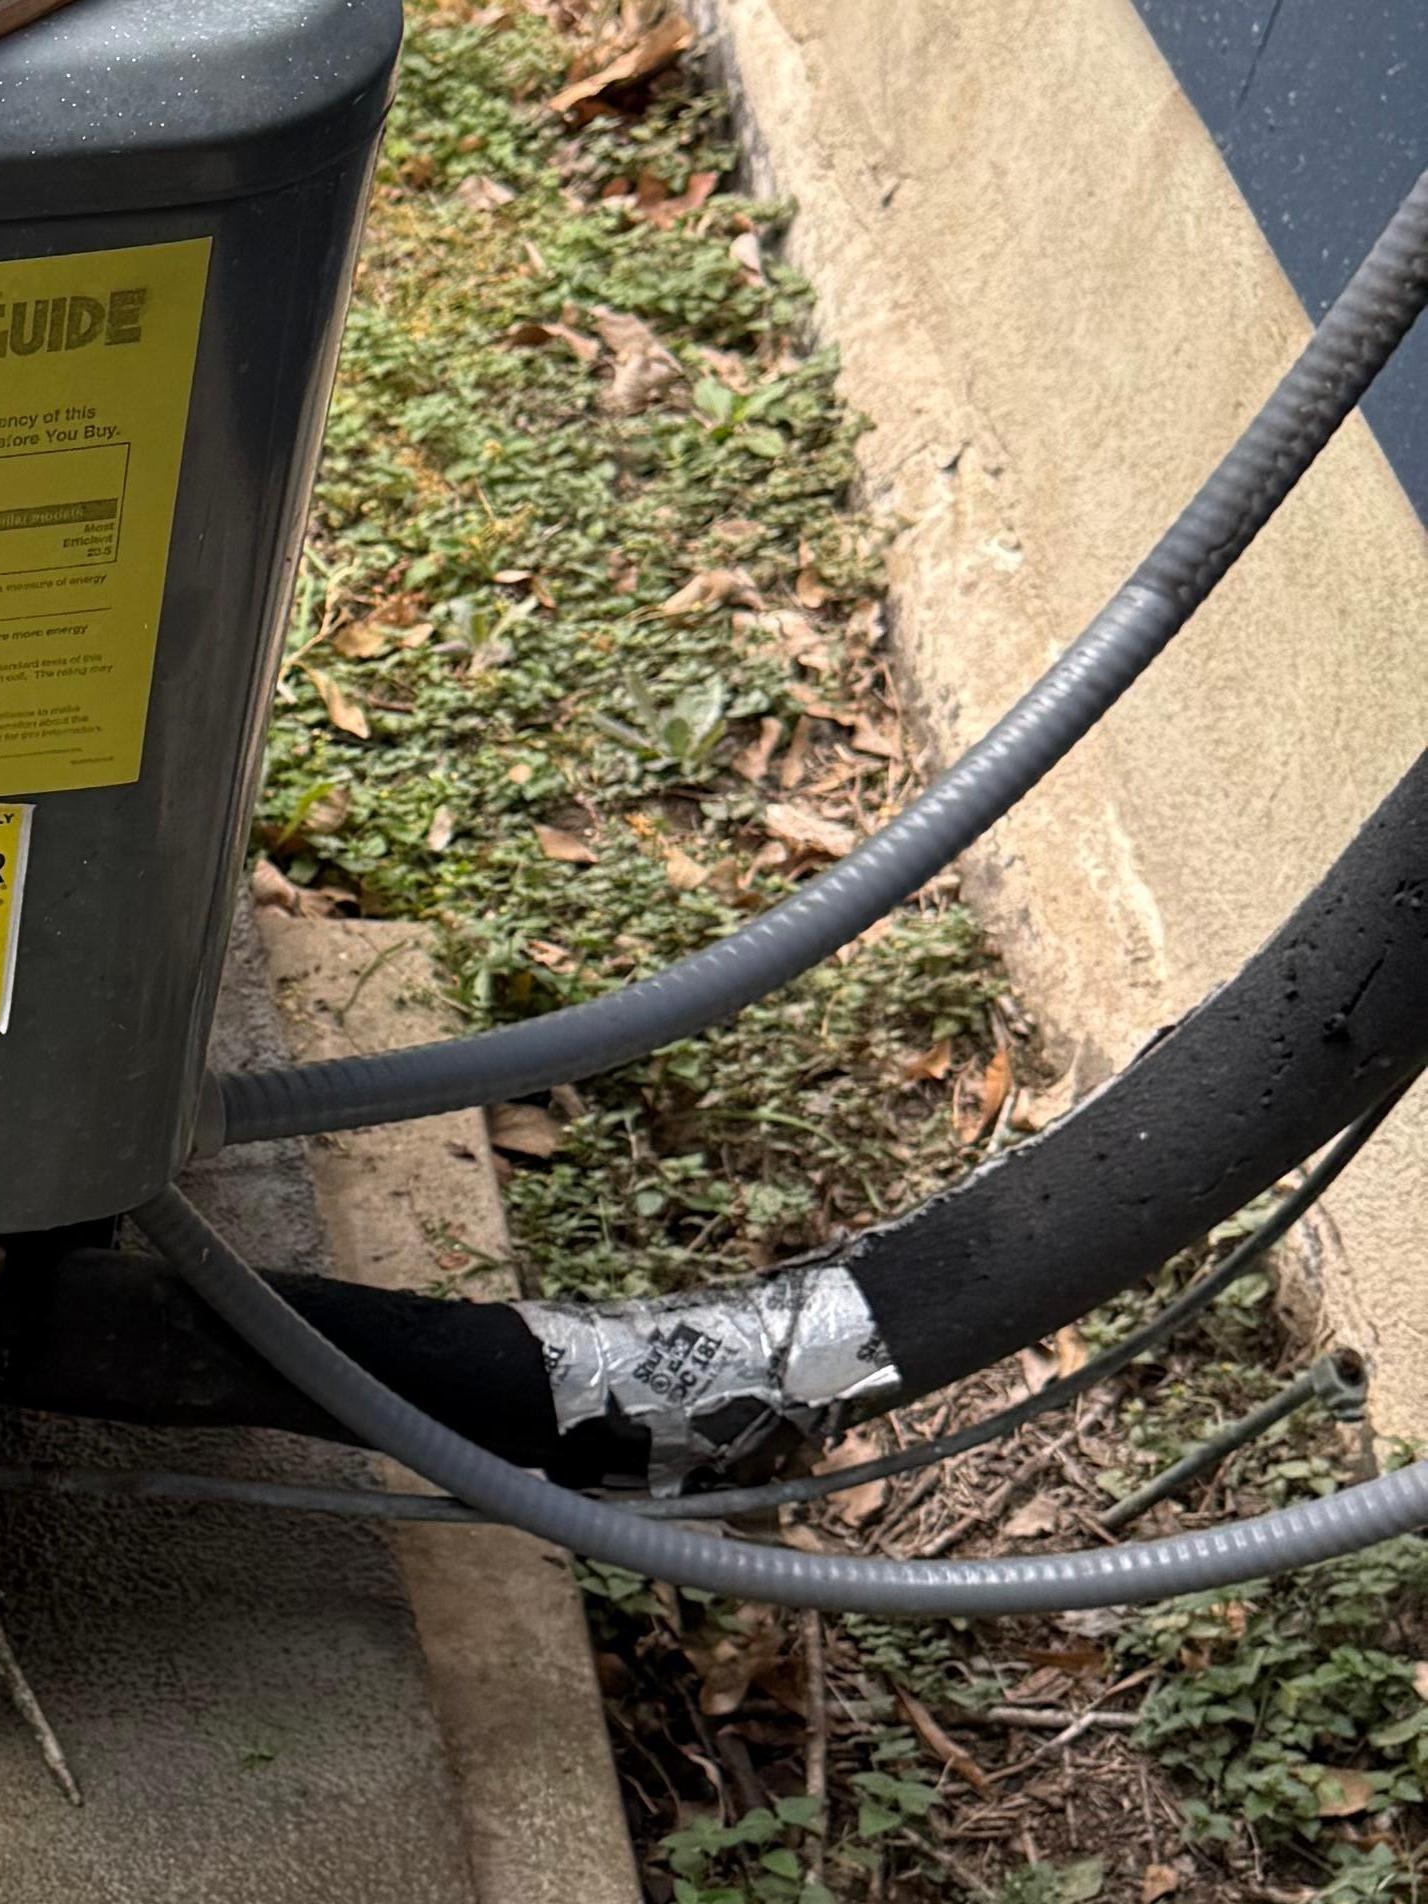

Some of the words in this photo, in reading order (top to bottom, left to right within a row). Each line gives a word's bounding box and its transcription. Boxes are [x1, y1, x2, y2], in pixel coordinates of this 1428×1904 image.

[42, 408, 60, 424] of
[64, 405, 97, 421] this
[44, 426, 78, 443] You
[83, 421, 121, 441] Buy.
